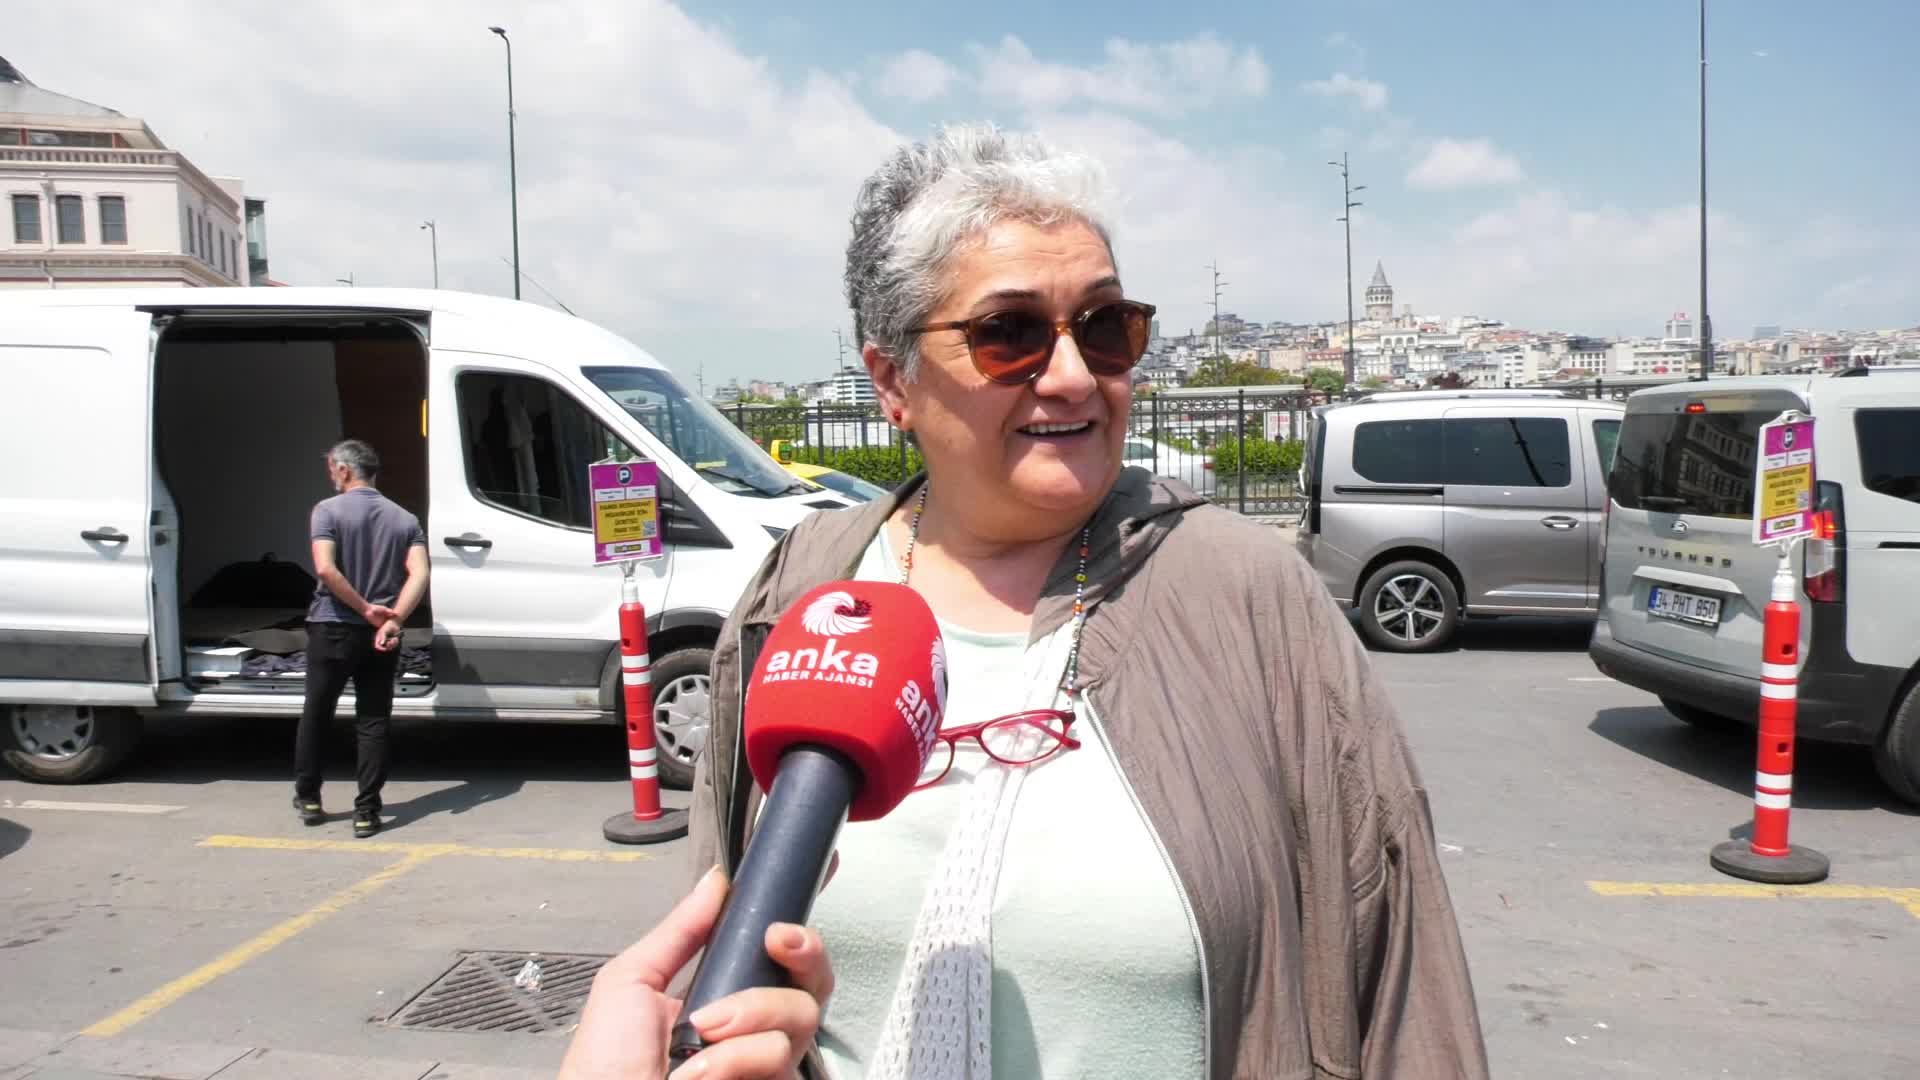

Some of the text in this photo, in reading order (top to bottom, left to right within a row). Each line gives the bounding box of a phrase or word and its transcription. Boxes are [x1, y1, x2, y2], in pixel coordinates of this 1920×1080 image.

[619, 470, 629, 480] P
[1655, 590, 1668, 610] 34
[1671, 593, 1693, 615] PHT
[766, 638, 879, 677] anka
[762, 670, 874, 689] HABER AJANSI
